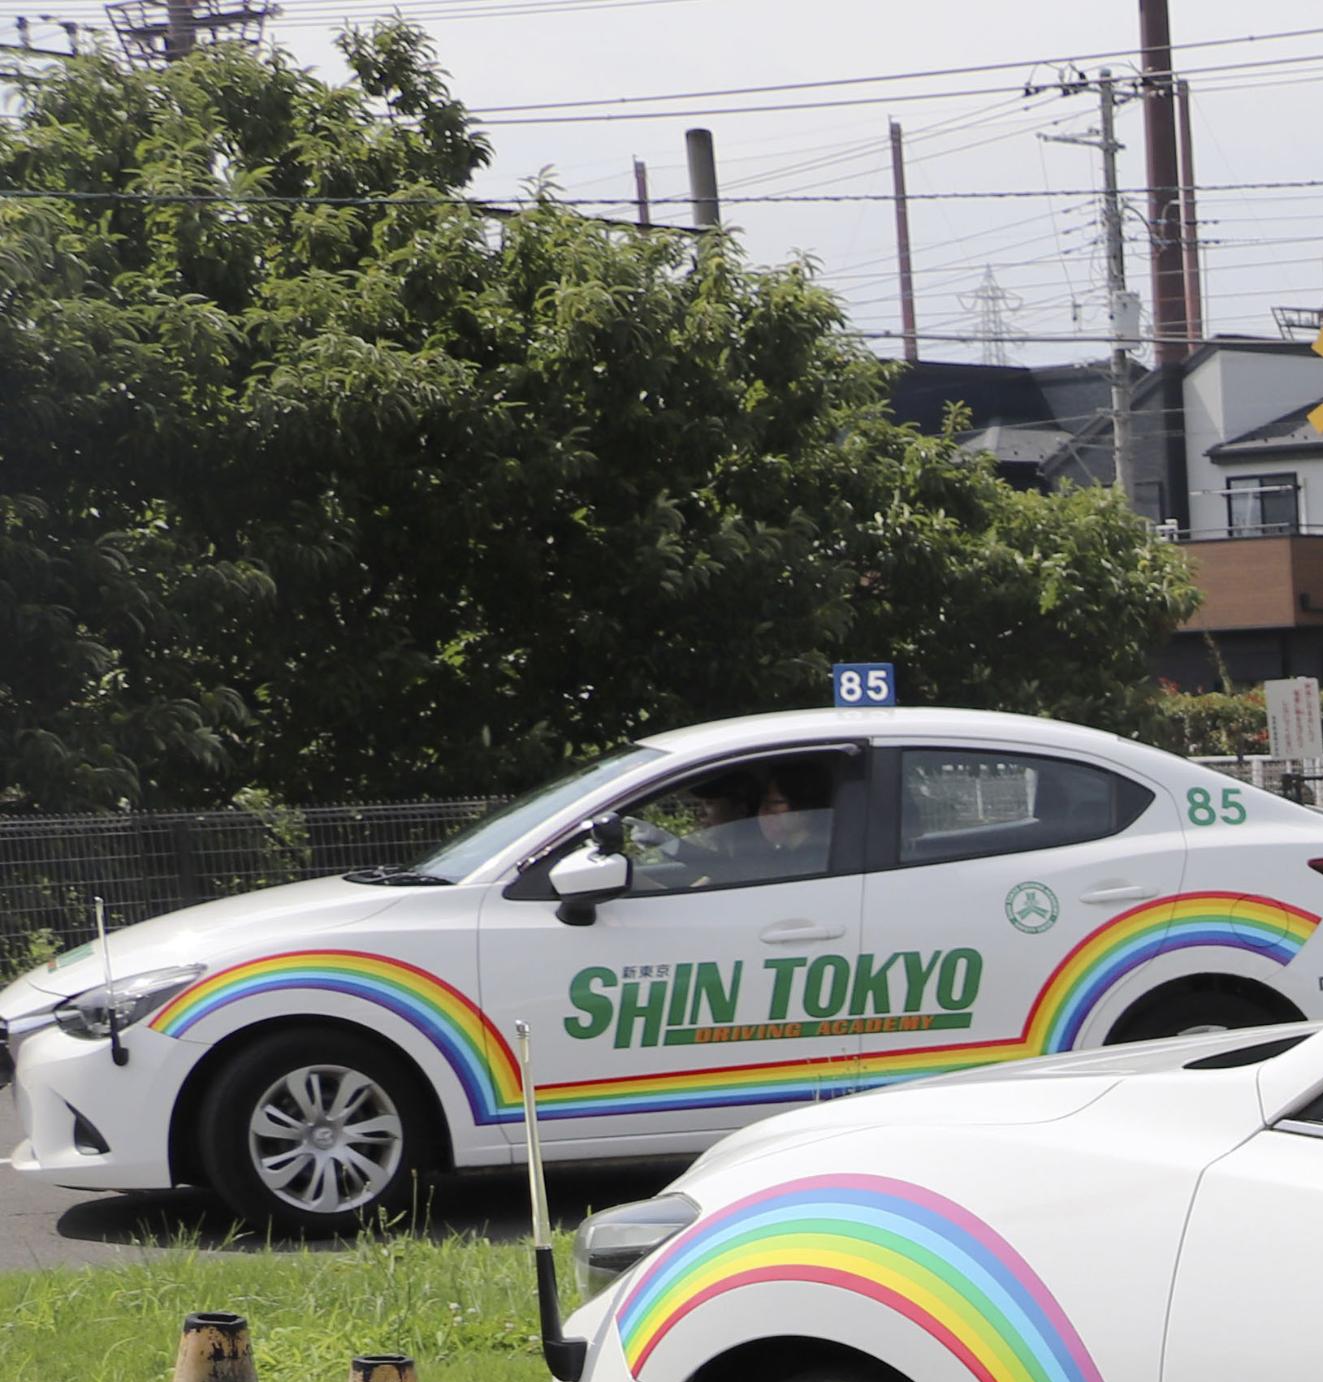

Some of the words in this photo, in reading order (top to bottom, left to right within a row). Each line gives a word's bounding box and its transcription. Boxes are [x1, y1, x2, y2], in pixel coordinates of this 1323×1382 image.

[839, 669, 890, 703] 85
[1187, 787, 1247, 826] 85
[622, 963, 671, 979] 新東京
[563, 959, 743, 1049] SHIN
[764, 947, 983, 1021] TOKYO
[695, 1022, 802, 1044] DRIVING
[816, 1015, 935, 1036] ACADEMY
